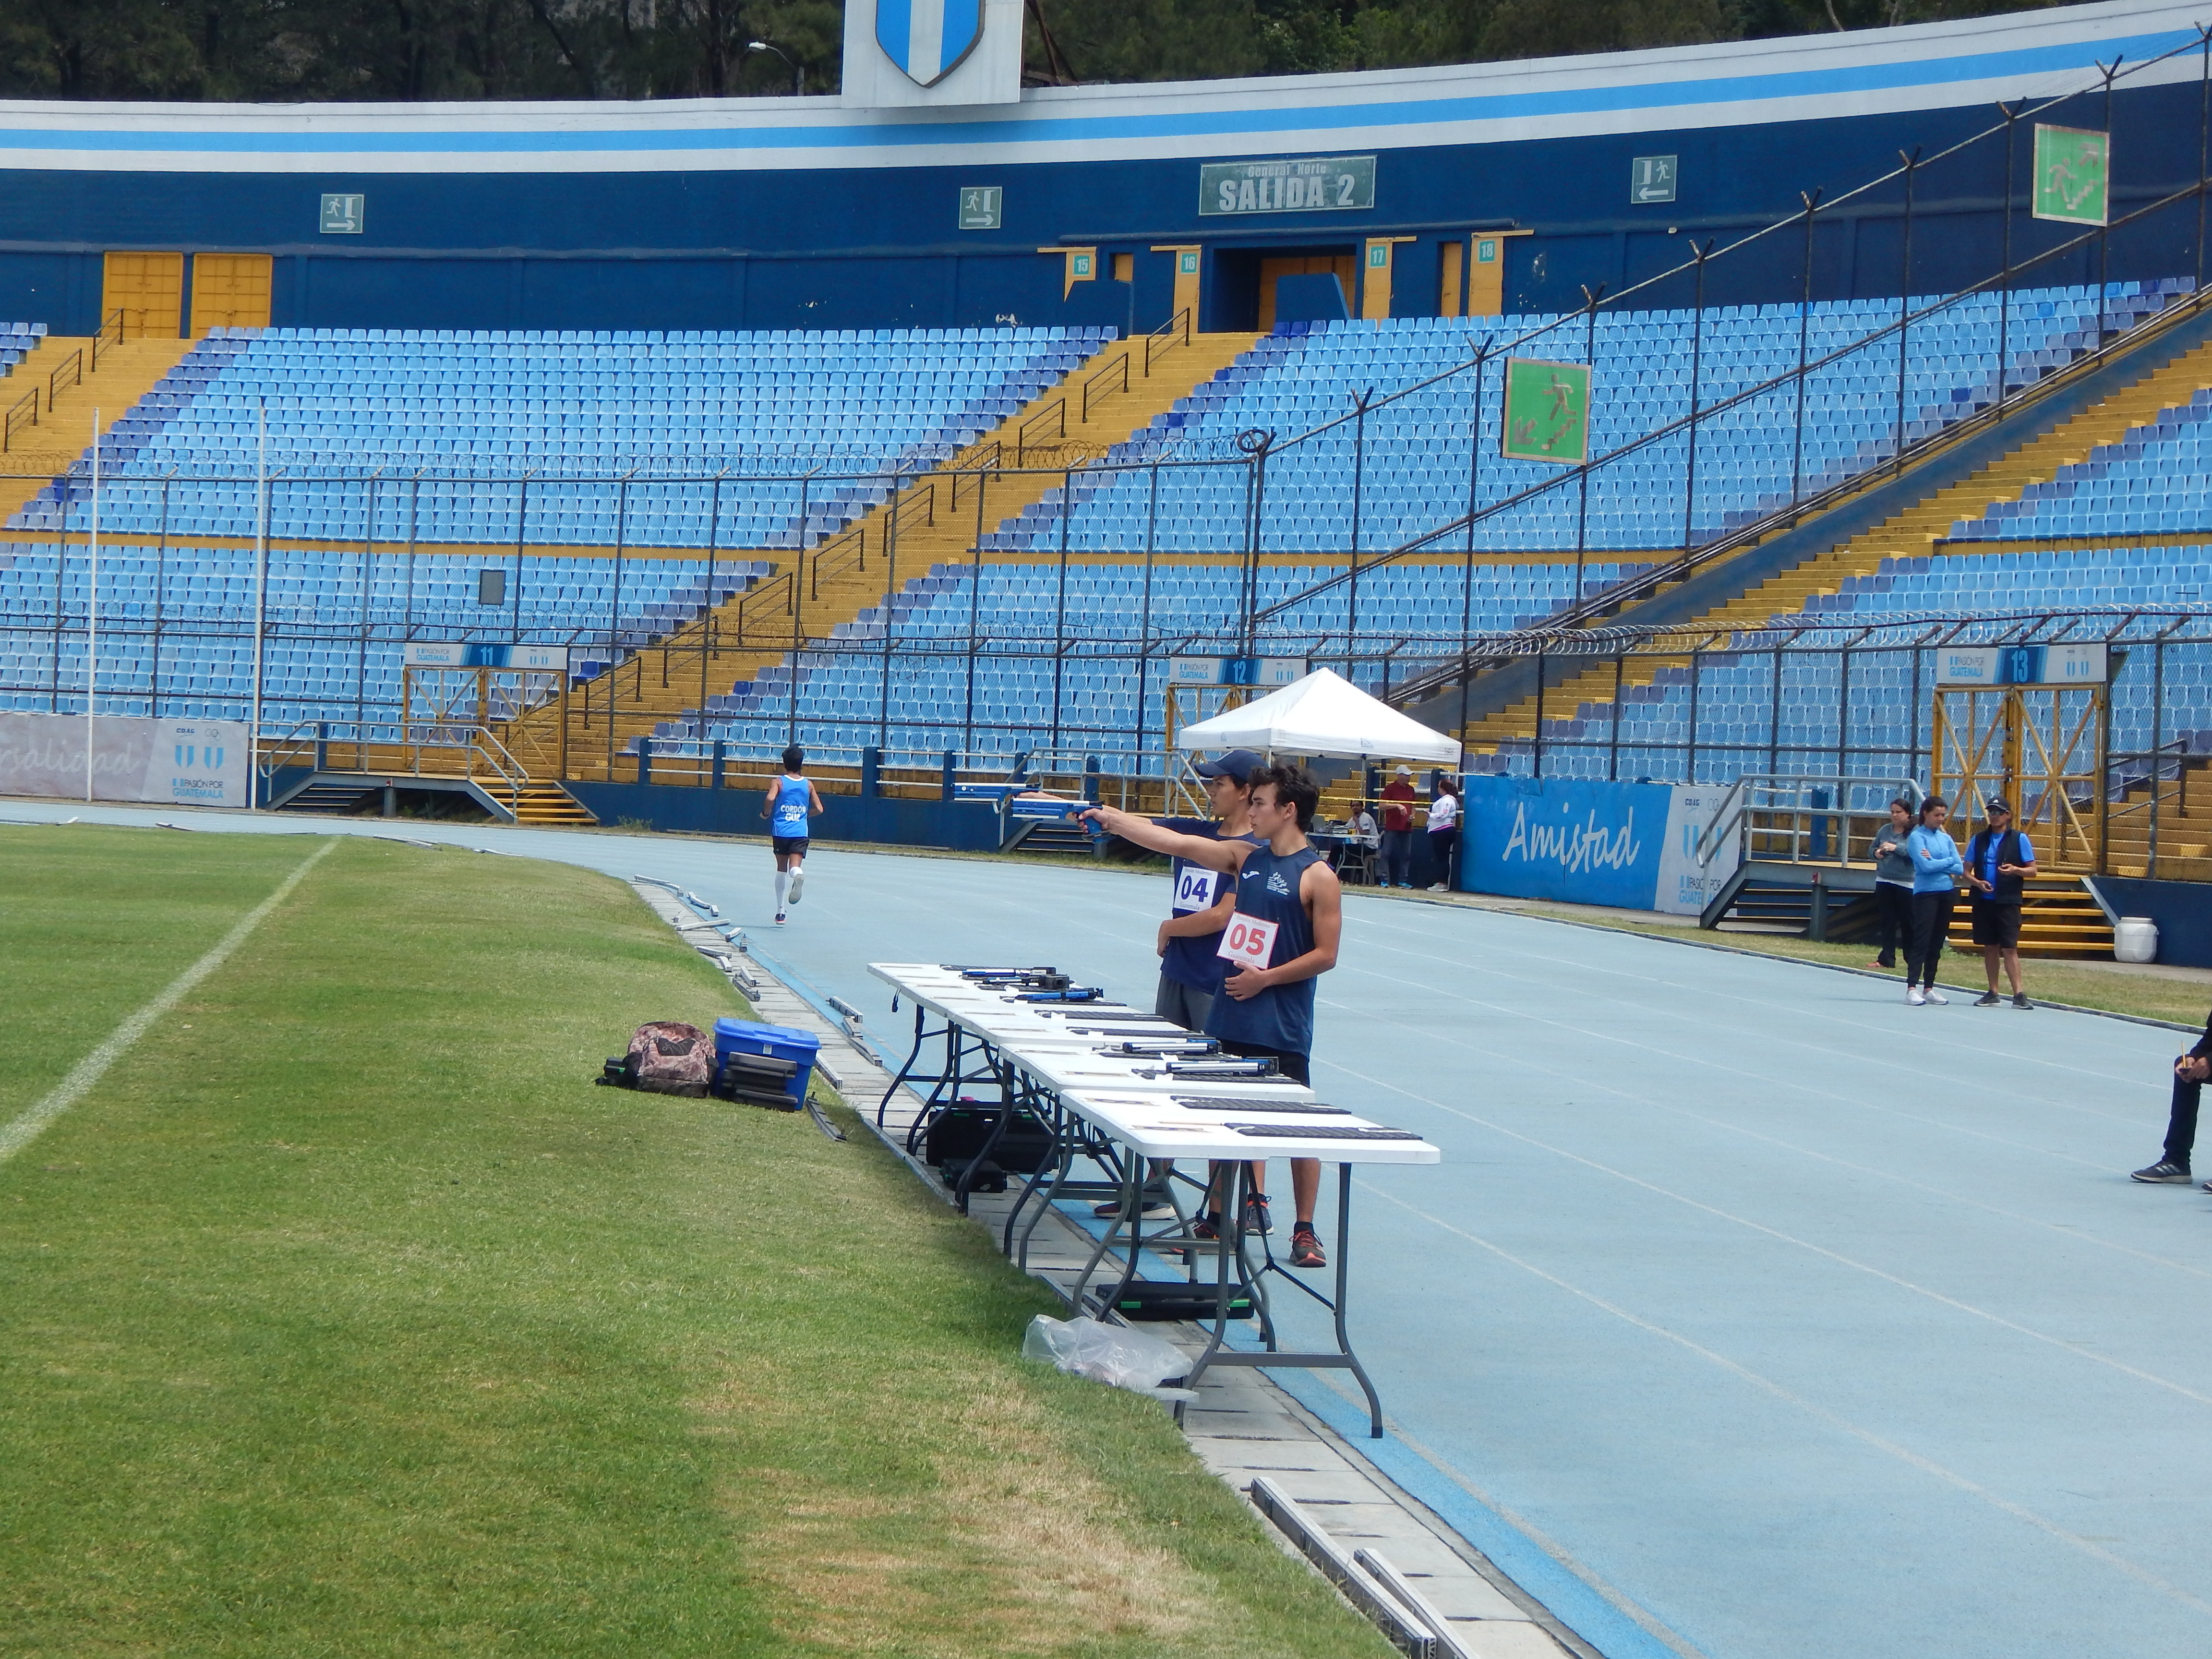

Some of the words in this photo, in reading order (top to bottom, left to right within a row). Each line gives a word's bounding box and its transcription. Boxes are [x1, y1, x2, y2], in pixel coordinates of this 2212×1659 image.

[1249, 164, 1290, 178] General
[1219, 176, 1324, 211] SALIDA
[1337, 174, 1355, 206] 2
[1372, 250, 1383, 264] 17
[1481, 243, 1493, 258] 18
[1077, 258, 1089, 272] 15
[1183, 256, 1196, 270] 16
[481, 647, 493, 665] 11
[1233, 661, 1247, 684] 12
[1949, 666, 1983, 677] GUATEMALA
[2011, 650, 2028, 683] 13
[1179, 671, 1208, 679] GUATEMALA
[185, 779, 208, 788] PASIÓN
[209, 781, 223, 789] POR
[172, 787, 224, 799] GUATEMALA
[1502, 802, 1640, 873] Amistad
[1181, 875, 1209, 903] 04
[1229, 924, 1266, 956] 05
[1228, 951, 1255, 964] Guatemala
